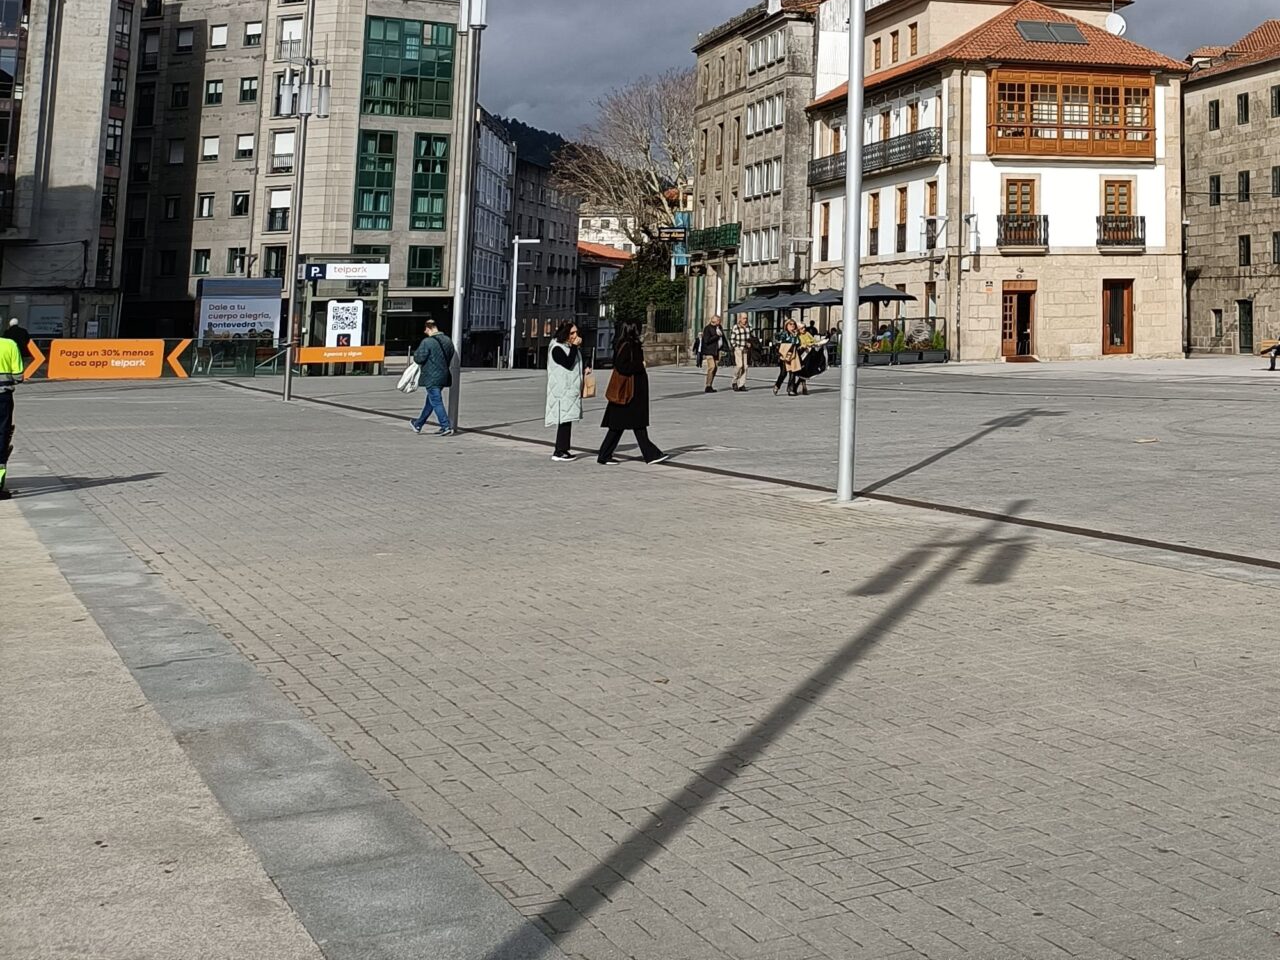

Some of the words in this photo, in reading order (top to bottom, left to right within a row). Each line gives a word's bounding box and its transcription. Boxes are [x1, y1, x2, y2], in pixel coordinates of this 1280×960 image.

[334, 266, 368, 274] telpark
[240, 312, 271, 320] alegría,
[60, 350, 85, 358] Paga
[89, 360, 108, 368] app
[111, 359, 146, 368] telpark
